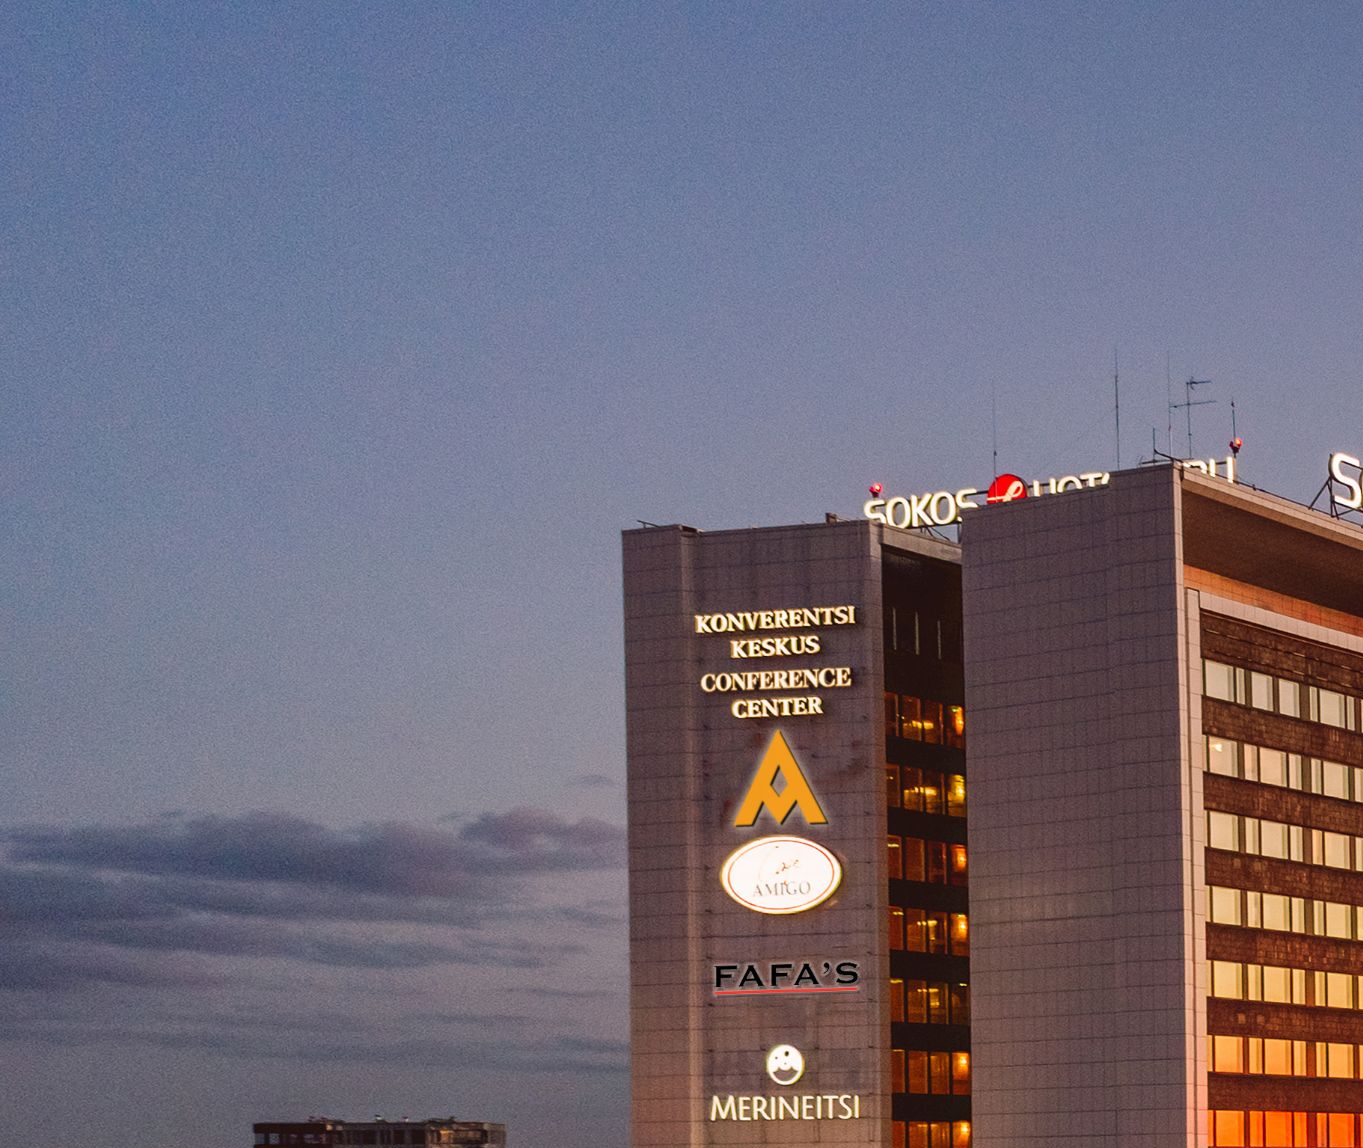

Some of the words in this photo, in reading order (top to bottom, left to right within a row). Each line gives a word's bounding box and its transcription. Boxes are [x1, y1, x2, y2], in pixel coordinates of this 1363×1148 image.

[695, 605, 857, 634] KONVERENTSI
[730, 635, 821, 660] KESKUS
[700, 667, 852, 693] CONFERENCE
[731, 696, 824, 719] CENTER
[753, 881, 812, 897] AMIGO
[714, 962, 859, 988] FAFA'S
[710, 1095, 861, 1122] MERINEITSI
